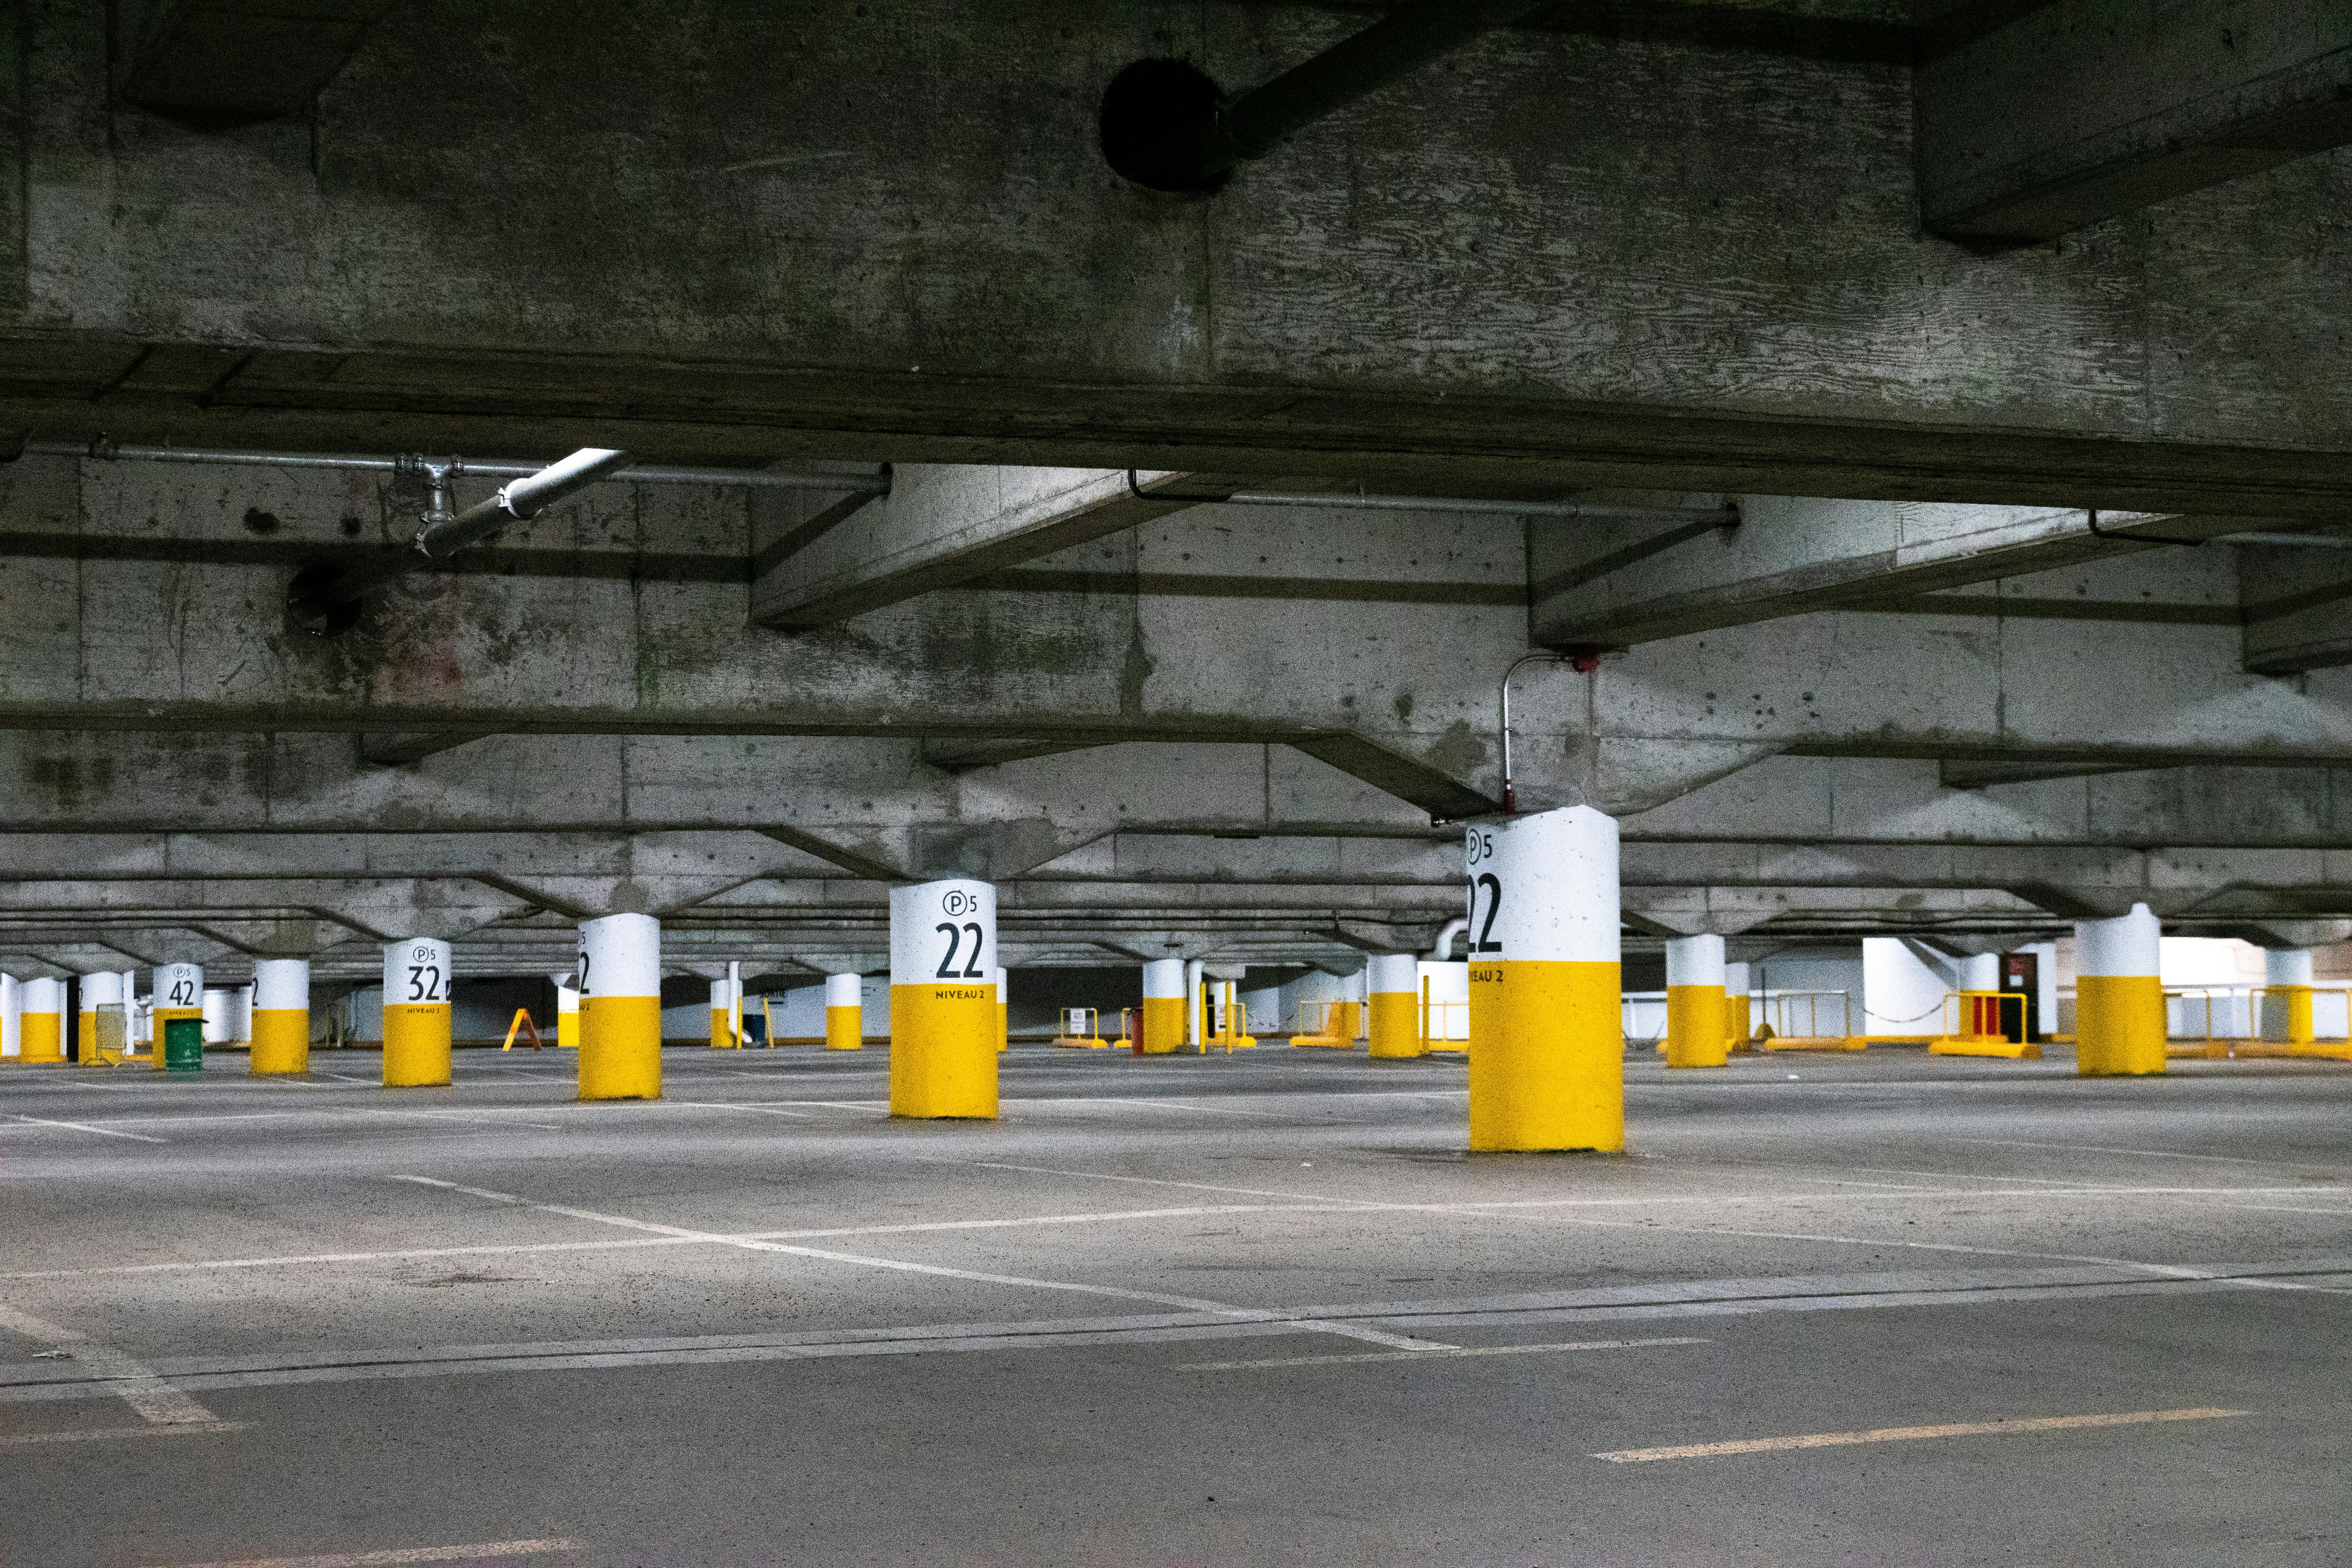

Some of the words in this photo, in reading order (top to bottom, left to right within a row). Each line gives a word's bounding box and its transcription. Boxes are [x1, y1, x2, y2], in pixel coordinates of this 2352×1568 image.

[935, 922, 983, 978] 22
[408, 965, 439, 1000] 32
[1496, 969, 1503, 982] 2
[169, 980, 194, 1005] 42
[935, 990, 977, 999] NIVEAU
[980, 990, 984, 999] 2
